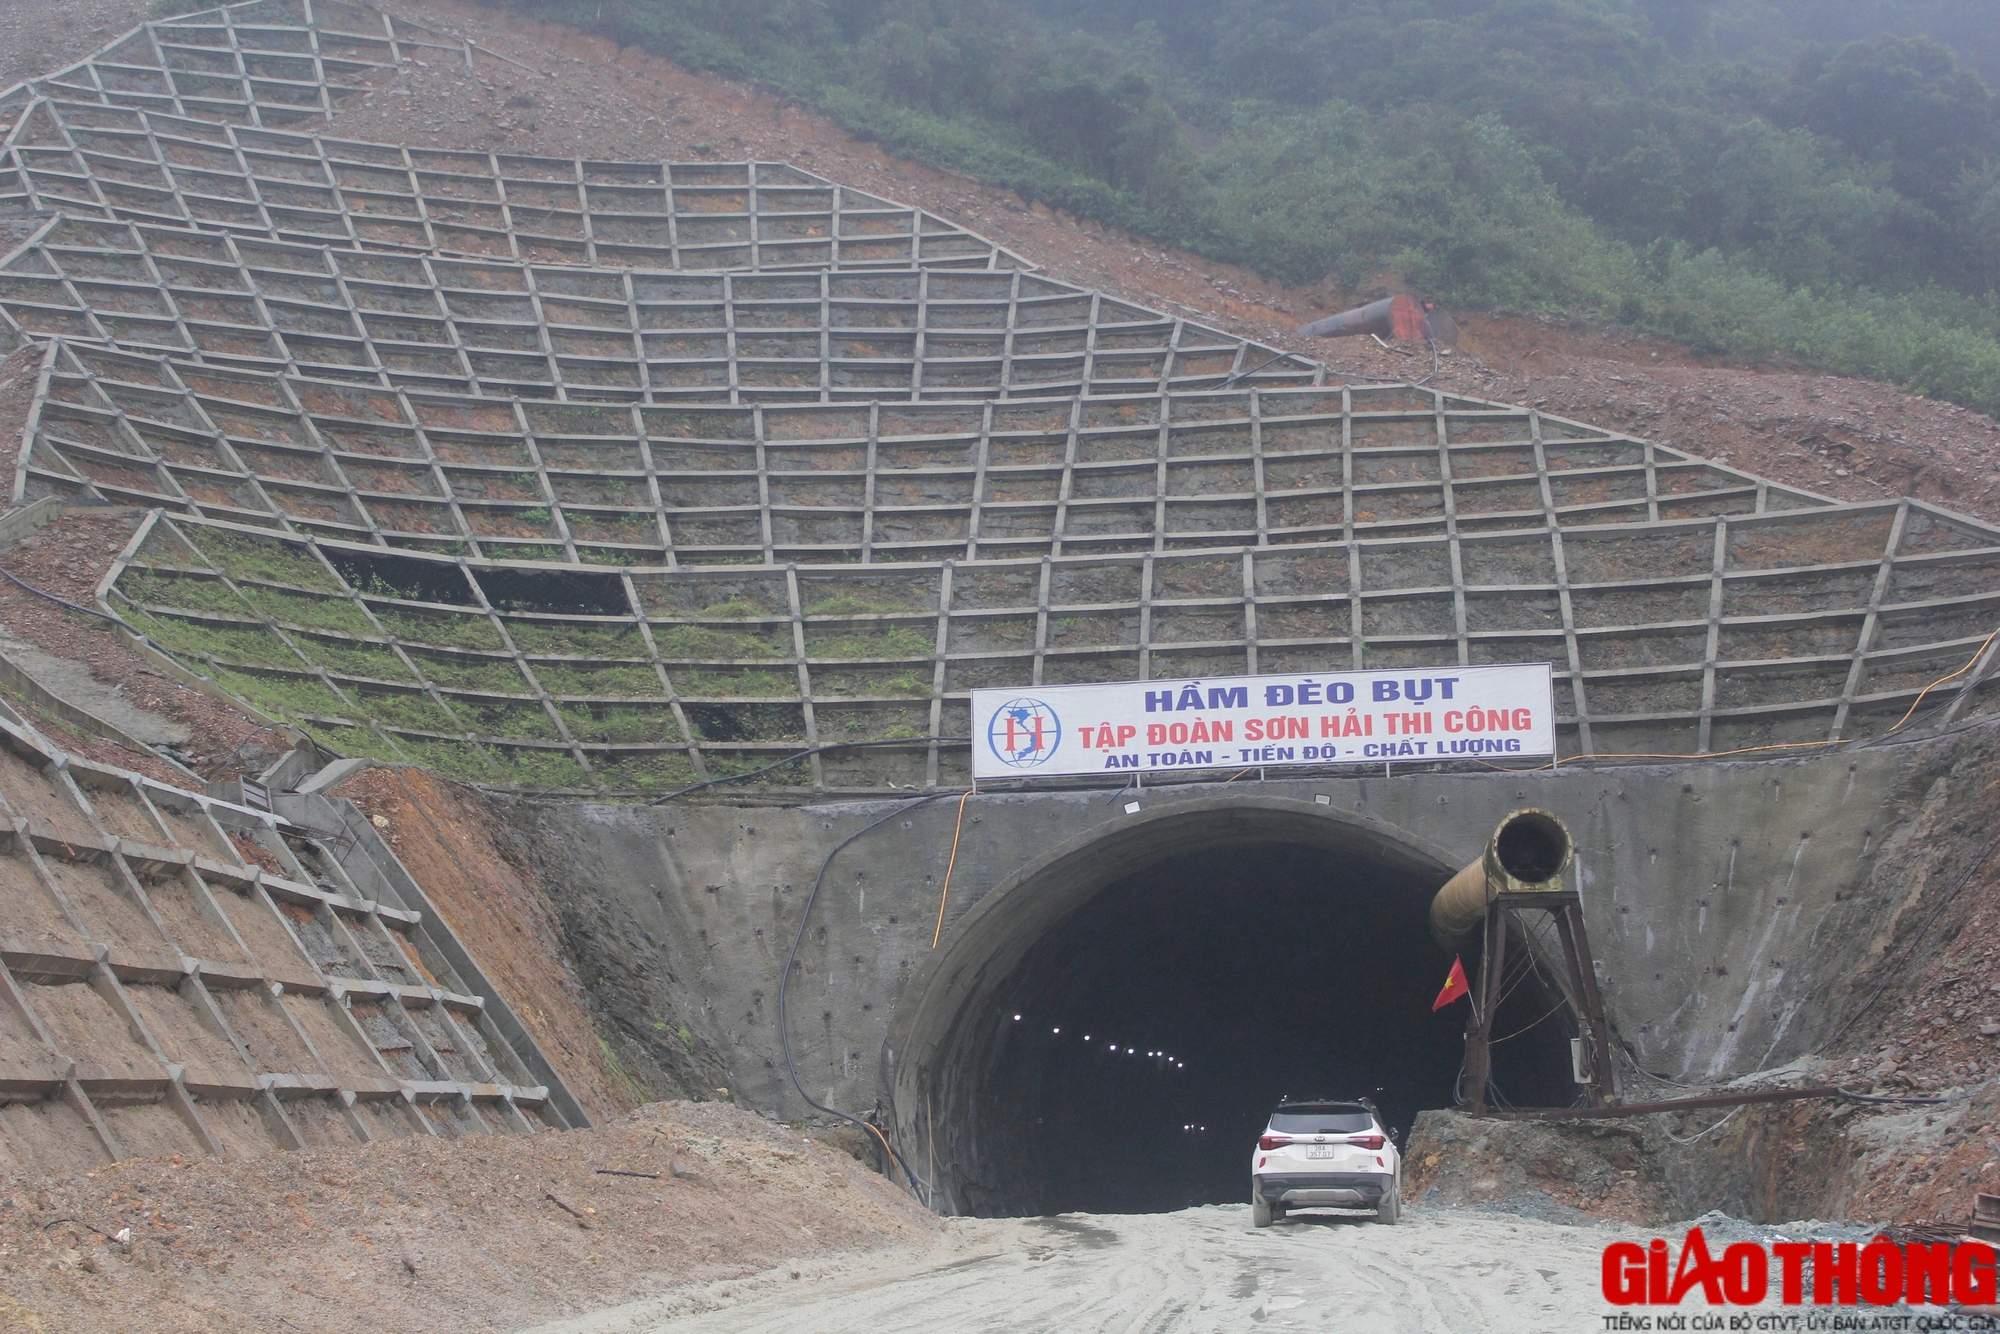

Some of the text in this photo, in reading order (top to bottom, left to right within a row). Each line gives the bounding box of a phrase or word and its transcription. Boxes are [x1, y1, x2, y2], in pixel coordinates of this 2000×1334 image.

[1144, 677, 1459, 713] HẦM ĐÈO BỤT
[1078, 705, 1532, 753] TẬP ĐOÀN SƠN HẢI THI CÔNG
[1104, 754, 1139, 768] AN
[1147, 749, 1212, 767] TOÀN
[1239, 743, 1294, 762] TIẾN
[1302, 743, 1336, 761] ĐỘ
[1363, 737, 1428, 757] CHẤT
[1437, 738, 1521, 755] LƯỢNG
